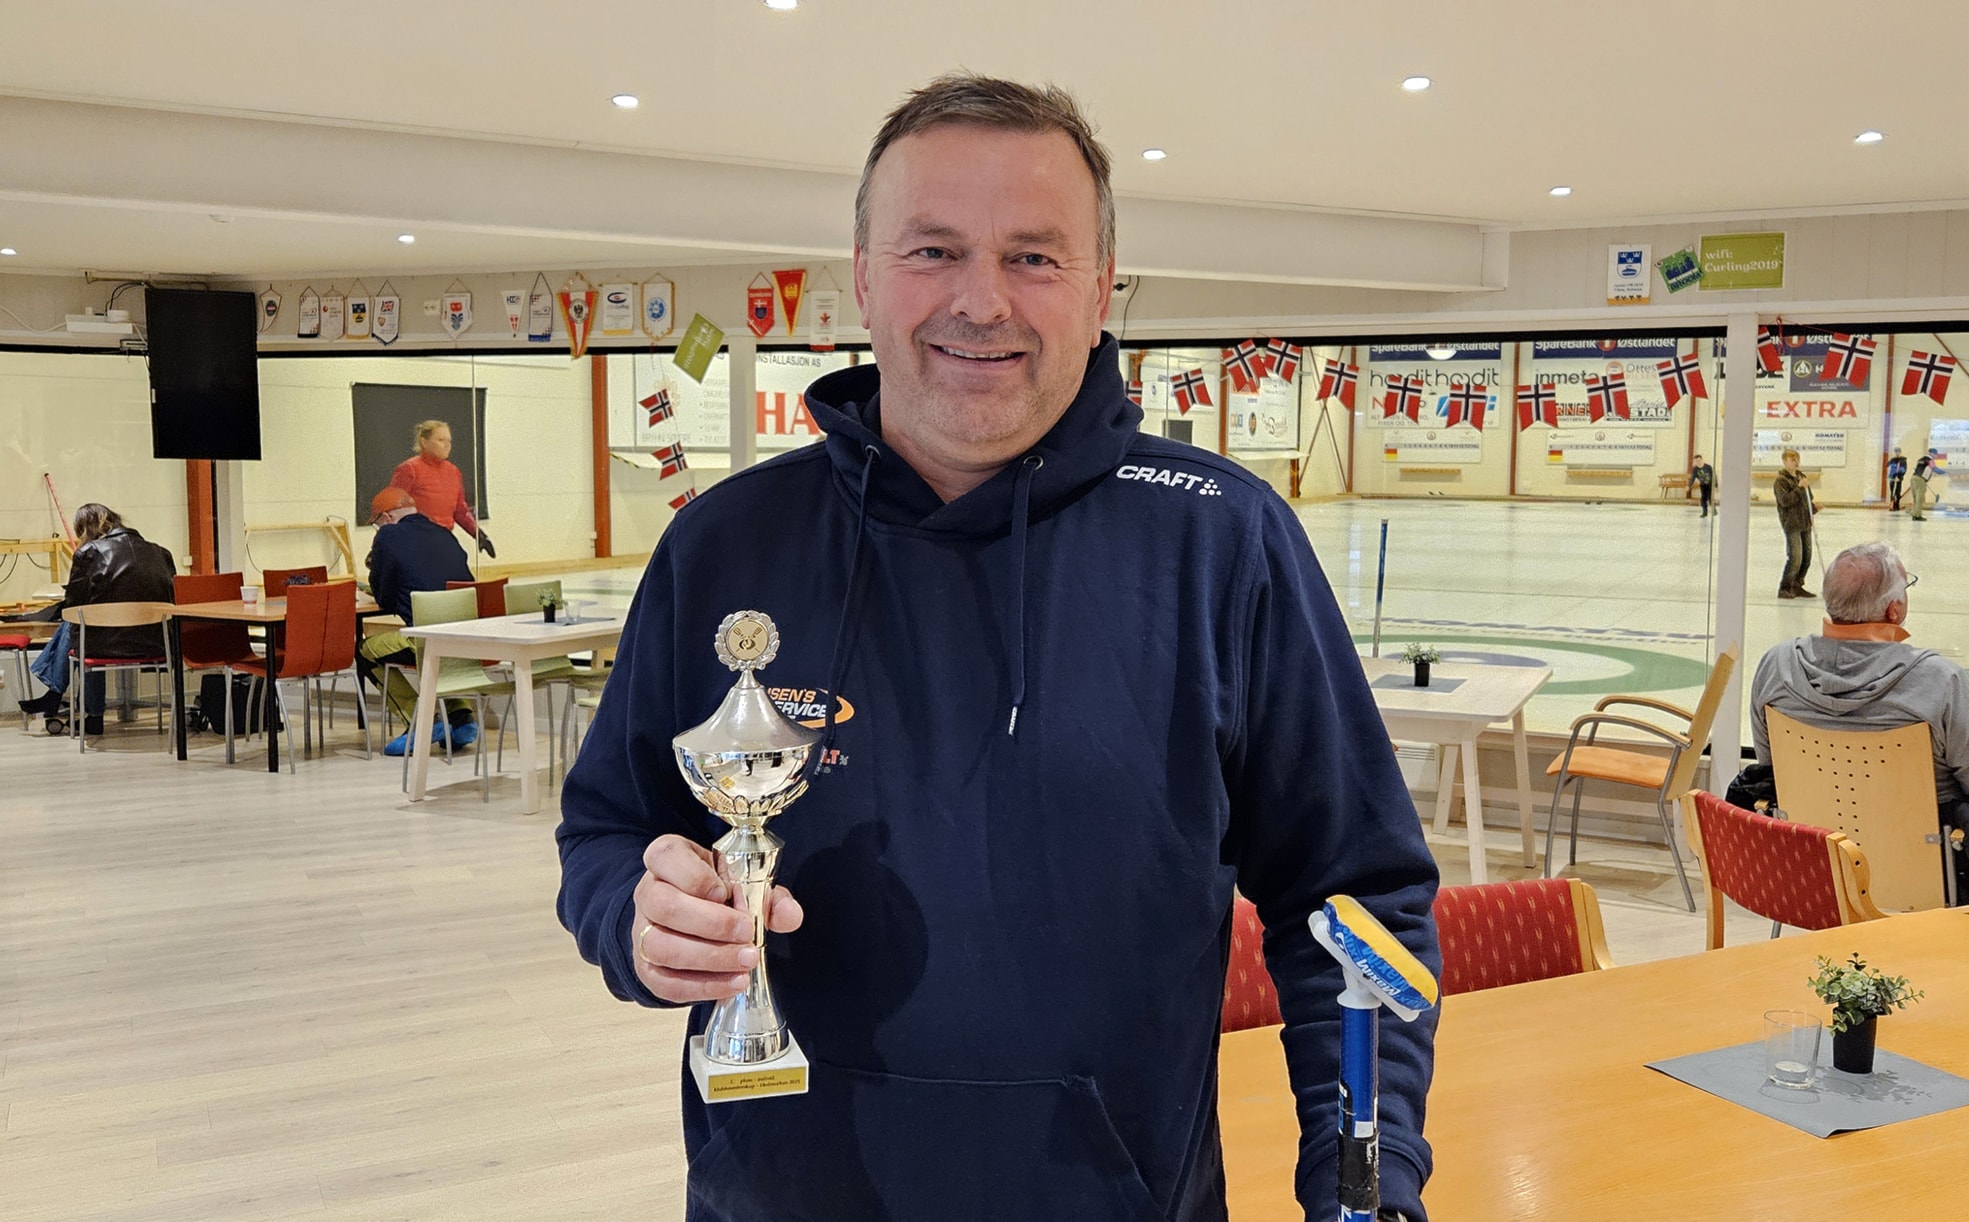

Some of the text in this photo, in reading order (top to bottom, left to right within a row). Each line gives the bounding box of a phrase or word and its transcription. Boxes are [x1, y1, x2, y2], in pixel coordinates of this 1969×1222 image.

[1705, 248, 1733, 260] wifi:
[1626, 363, 1656, 373] Ottes
[1767, 401, 1857, 418] EXTRA
[1116, 465, 1204, 490] CRAFT
[774, 701, 827, 718] ERVICE
